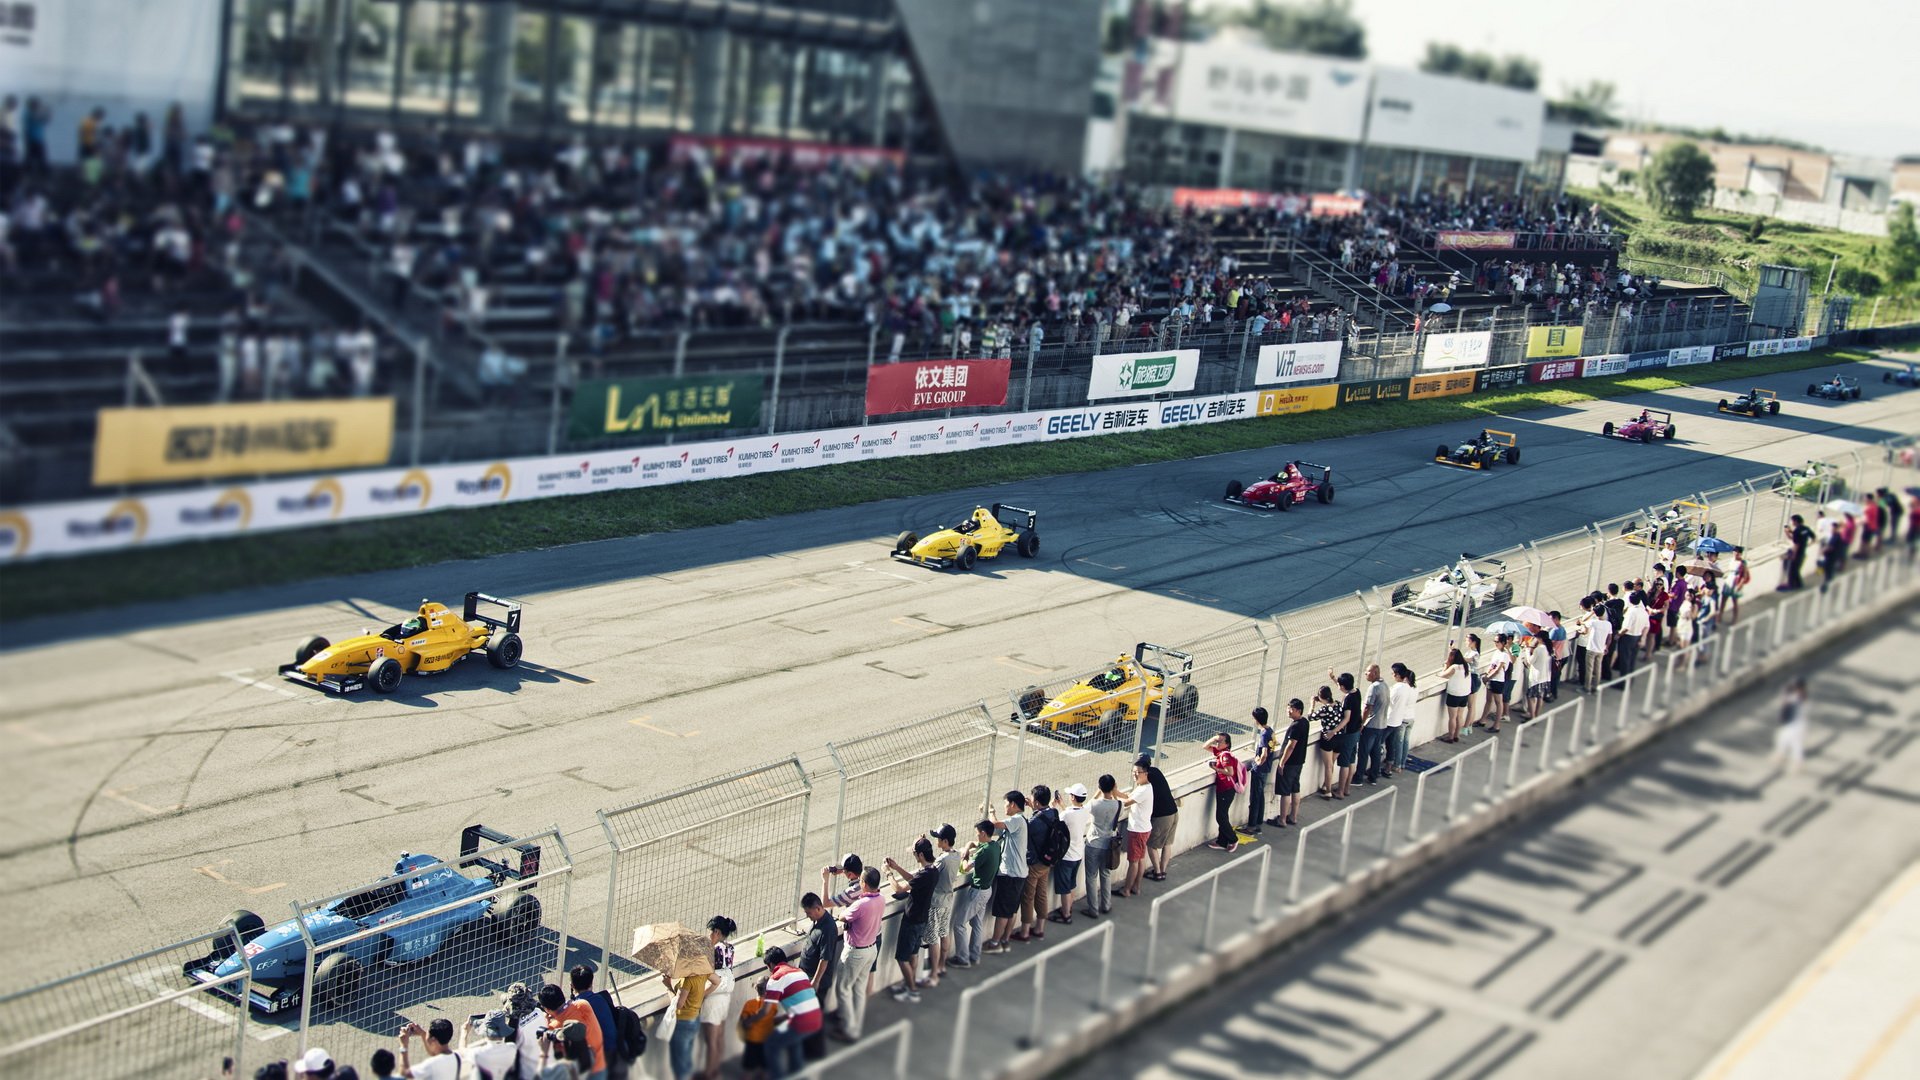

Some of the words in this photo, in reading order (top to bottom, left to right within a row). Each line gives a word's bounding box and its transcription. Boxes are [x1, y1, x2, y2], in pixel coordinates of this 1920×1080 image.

[915, 365, 969, 390] 依文集团
[914, 392, 933, 405] EVE
[934, 390, 966, 404] GROUP
[1161, 403, 1206, 424] GEELY
[1207, 399, 1247, 418] 吉利汽车
[1047, 412, 1101, 434] GEELY
[1102, 409, 1149, 430] 吉利汽车
[862, 439, 880, 448] KUMHO
[880, 437, 893, 446] TIRES
[910, 433, 927, 442] KUMHO
[927, 432, 940, 440] TIRES
[781, 447, 801, 457] KUMHO
[801, 446, 815, 454] TIRES
[822, 443, 841, 452] KUMHO
[841, 441, 855, 450] TIRES
[691, 457, 713, 466] KUMHO
[712, 455, 728, 464] TIRES
[738, 451, 759, 461] KUMHO
[759, 450, 773, 458] TIRES
[1028, 518, 1034, 528] 3
[511, 613, 518, 627] 7
